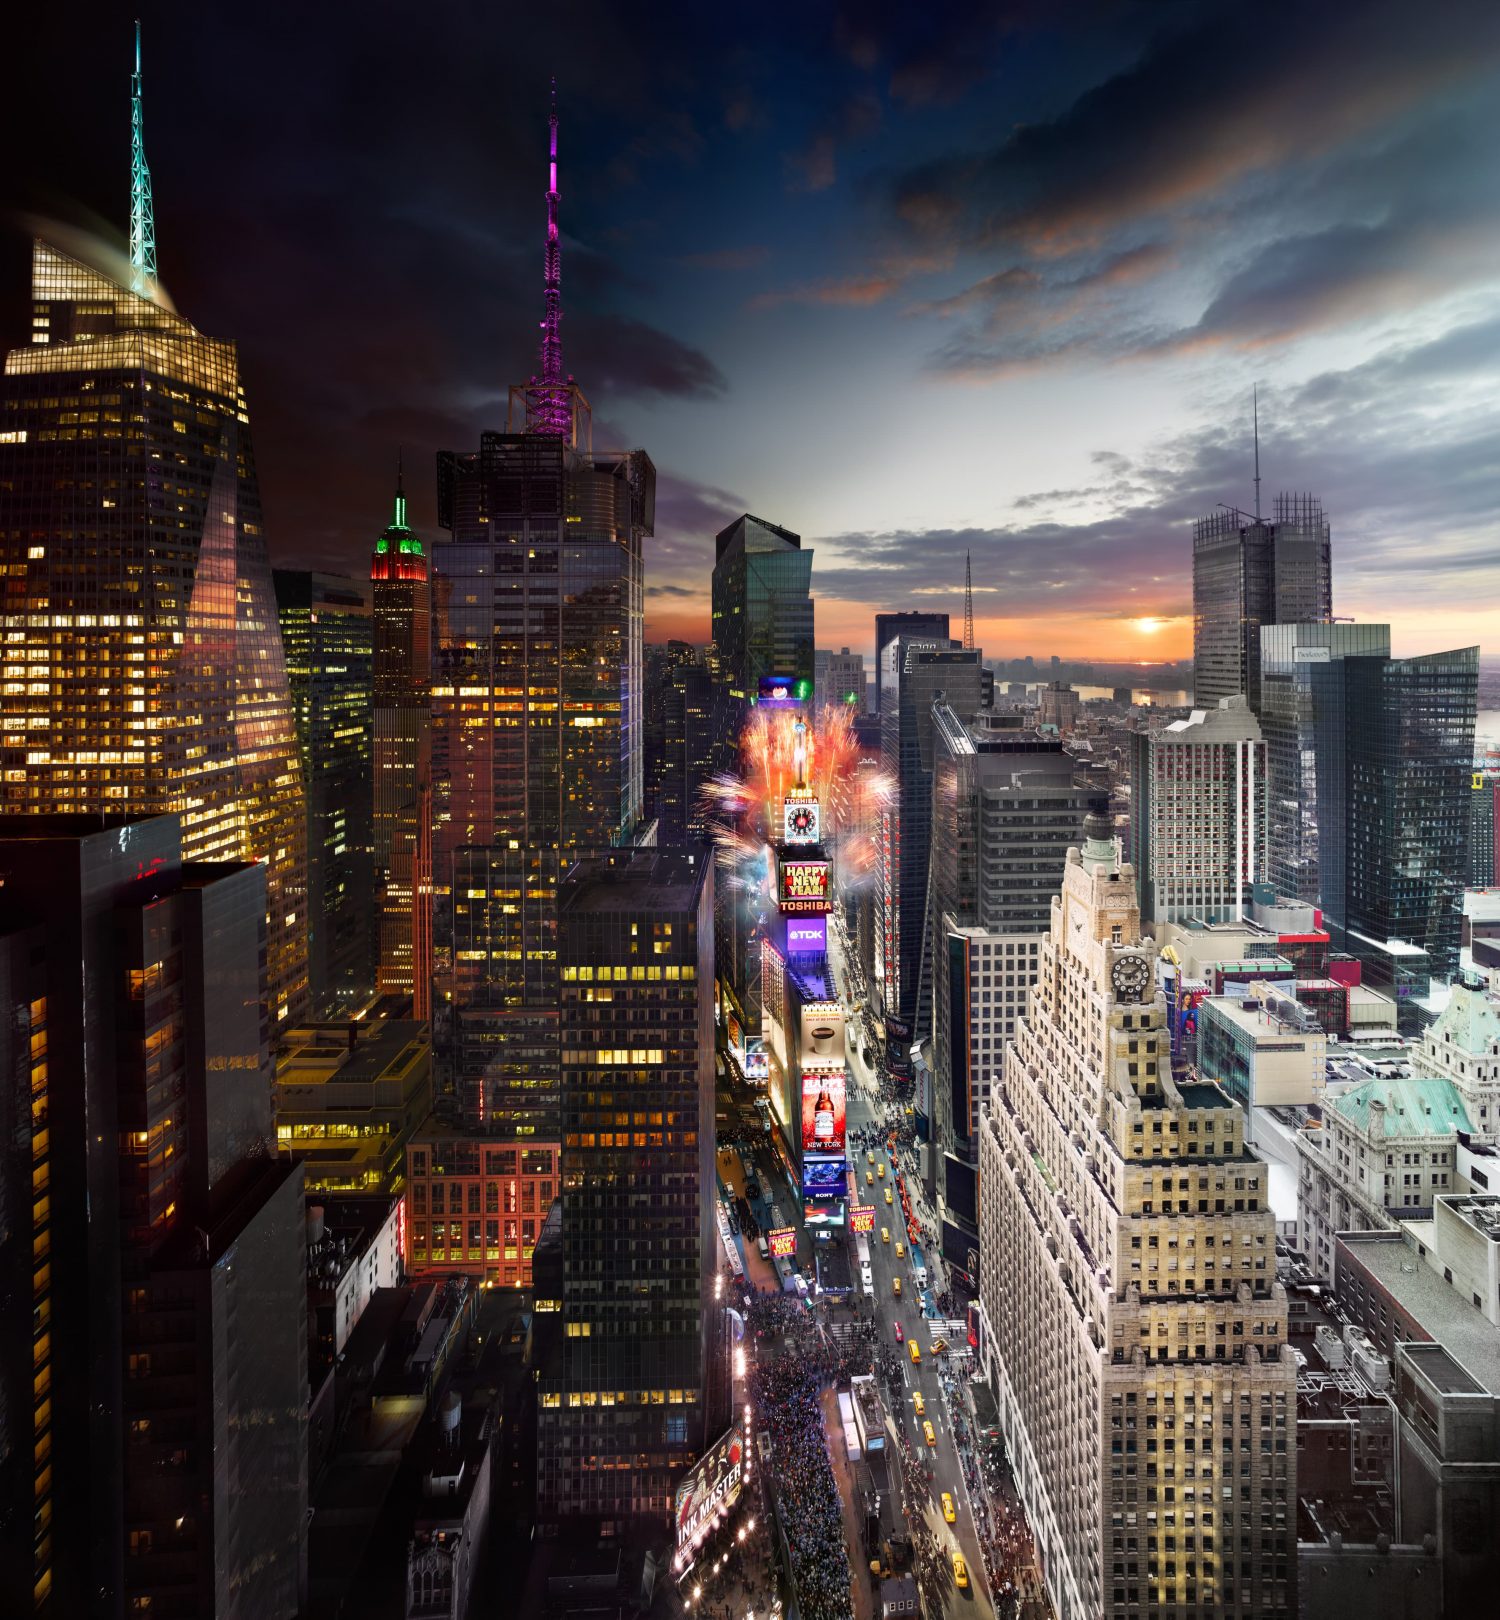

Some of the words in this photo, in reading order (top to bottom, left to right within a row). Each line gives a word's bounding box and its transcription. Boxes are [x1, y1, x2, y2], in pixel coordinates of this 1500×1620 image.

[786, 866, 827, 876] HAPPY
[793, 876, 820, 886] NEW
[789, 885, 824, 896] YEAR!
[780, 901, 832, 911] TOSHIBA
[797, 930, 823, 939] TDK
[848, 1205, 875, 1213] TOSHIBA
[851, 1214, 874, 1222] HAPPY
[855, 1219, 871, 1227] NEW
[768, 1226, 796, 1236] TOSHIBA
[772, 1235, 794, 1245] HAPPY
[774, 1241, 791, 1250] NEW
[678, 1510, 698, 1546] INK
[700, 1462, 741, 1520] MASTER
